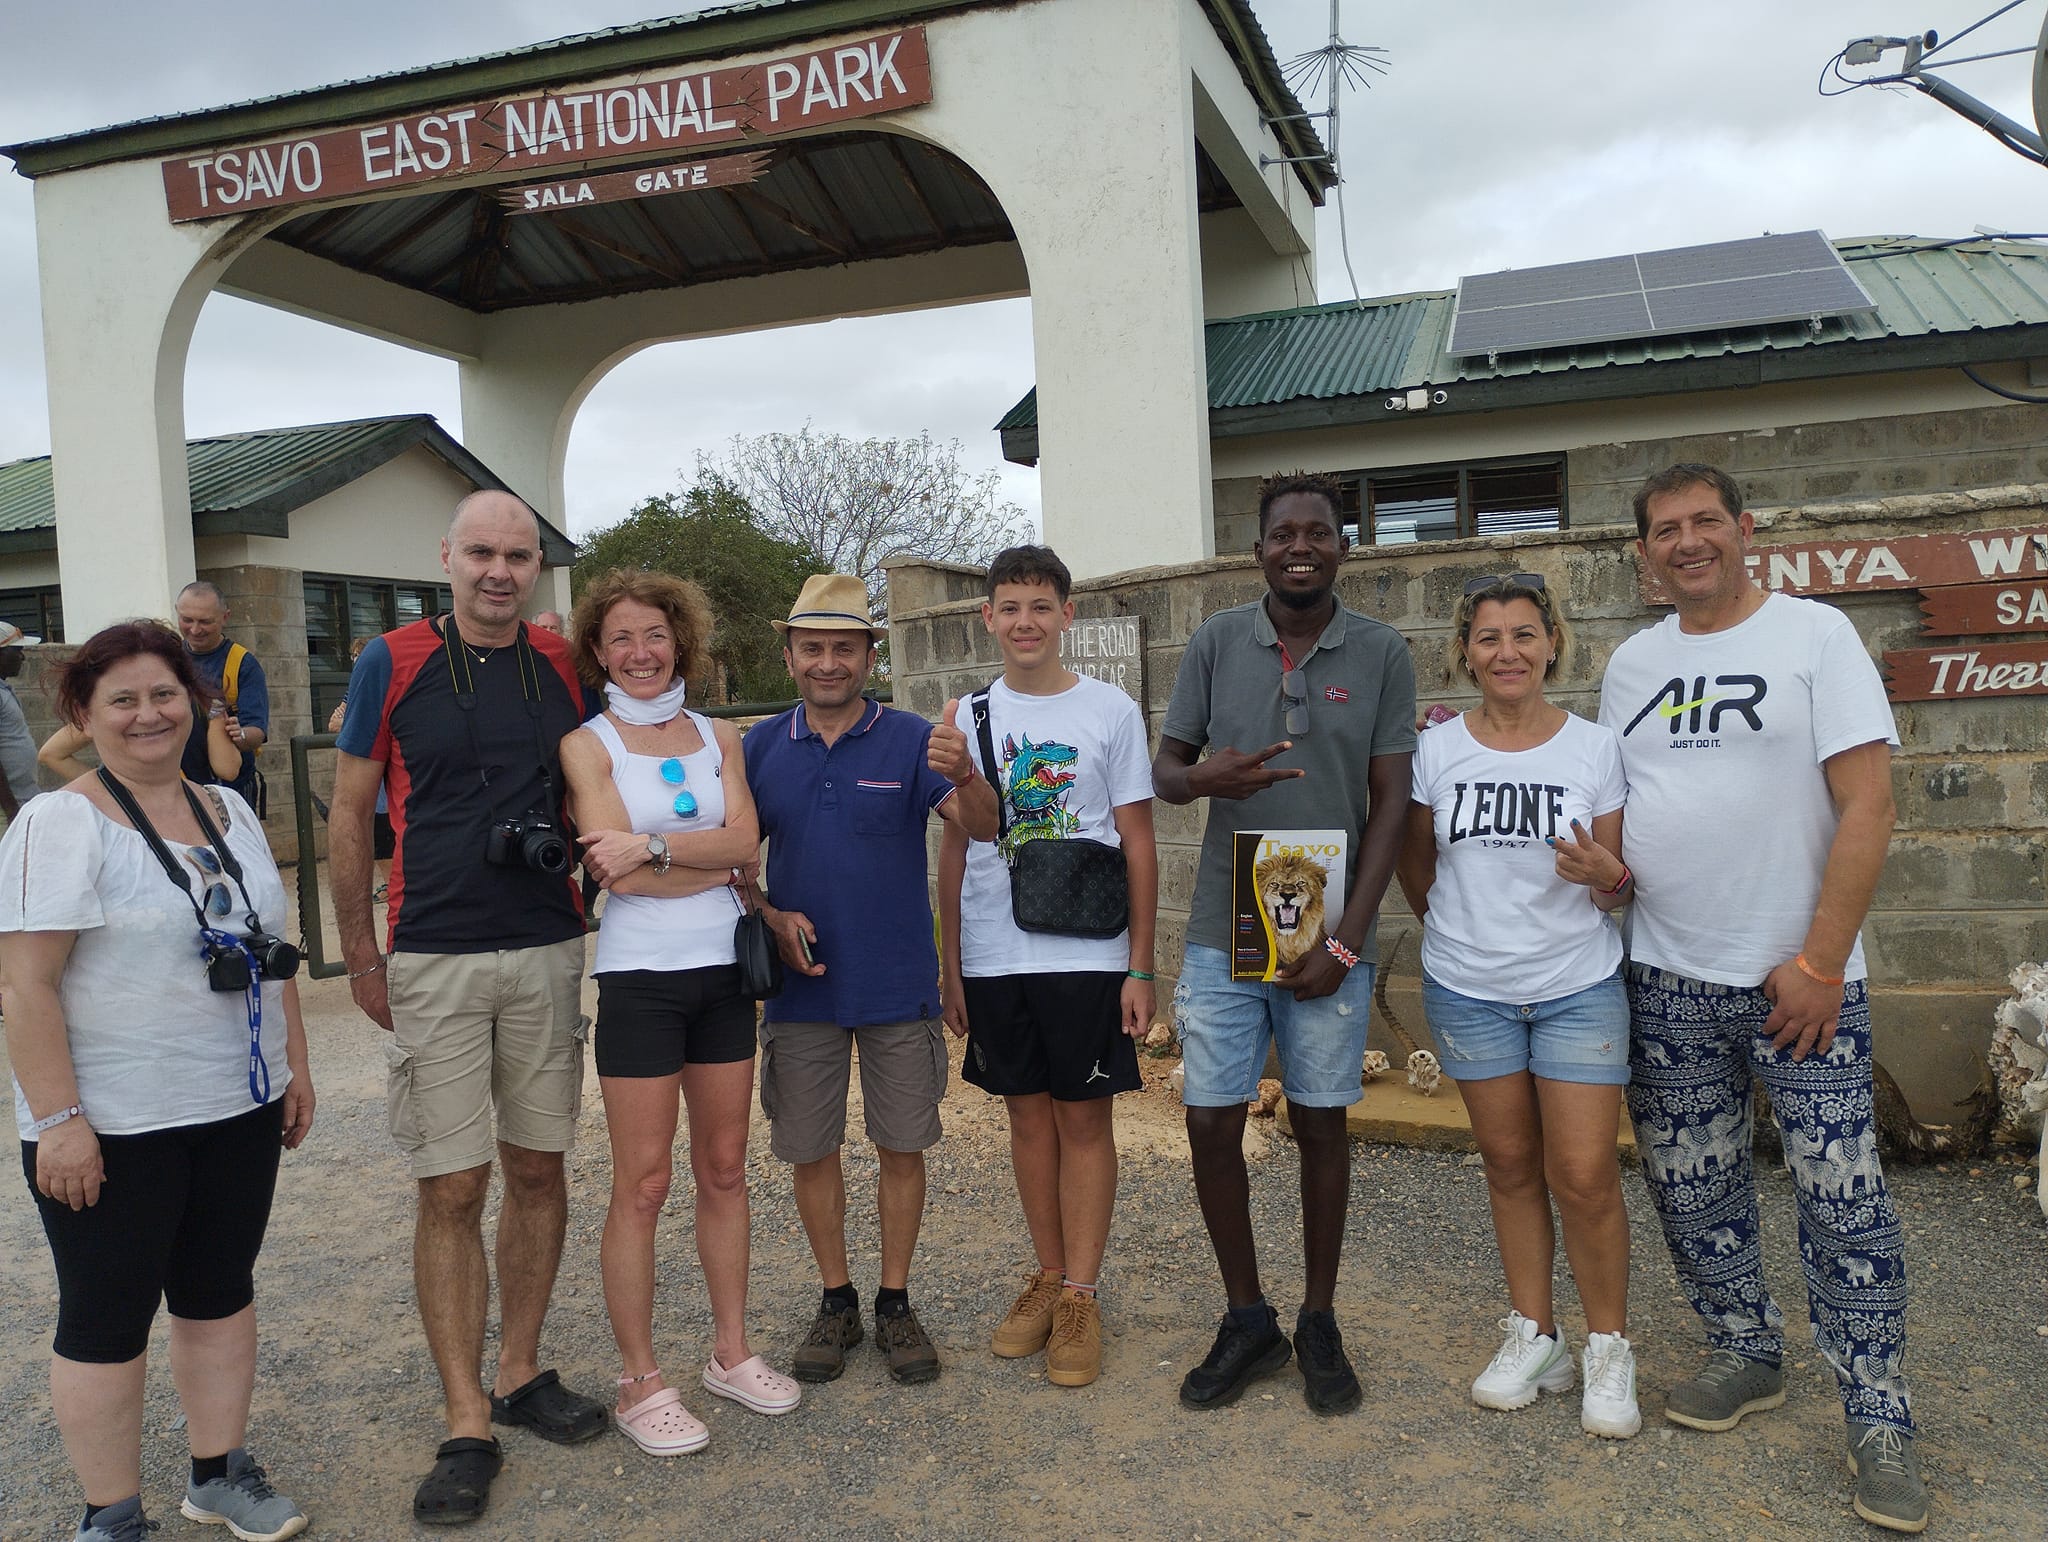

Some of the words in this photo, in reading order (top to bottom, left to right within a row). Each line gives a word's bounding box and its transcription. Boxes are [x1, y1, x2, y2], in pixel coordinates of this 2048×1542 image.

[188, 141, 323, 208] TSAVO
[360, 110, 476, 182] EAST
[505, 76, 737, 158] NATIONAL
[767, 36, 907, 122] PARK
[524, 183, 595, 210] SALA
[635, 165, 709, 193] GATE
[1744, 546, 1911, 590] ENYA
[1069, 624, 1096, 658] THE
[1098, 624, 1136, 658] ROAD
[1623, 674, 1768, 738] AIR
[1669, 739, 1695, 749] JUST
[1696, 739, 1710, 748] DO
[1449, 782, 1566, 845] LEONE
[1260, 839, 1341, 858] Tsavo
[1480, 839, 1529, 849] 1947
